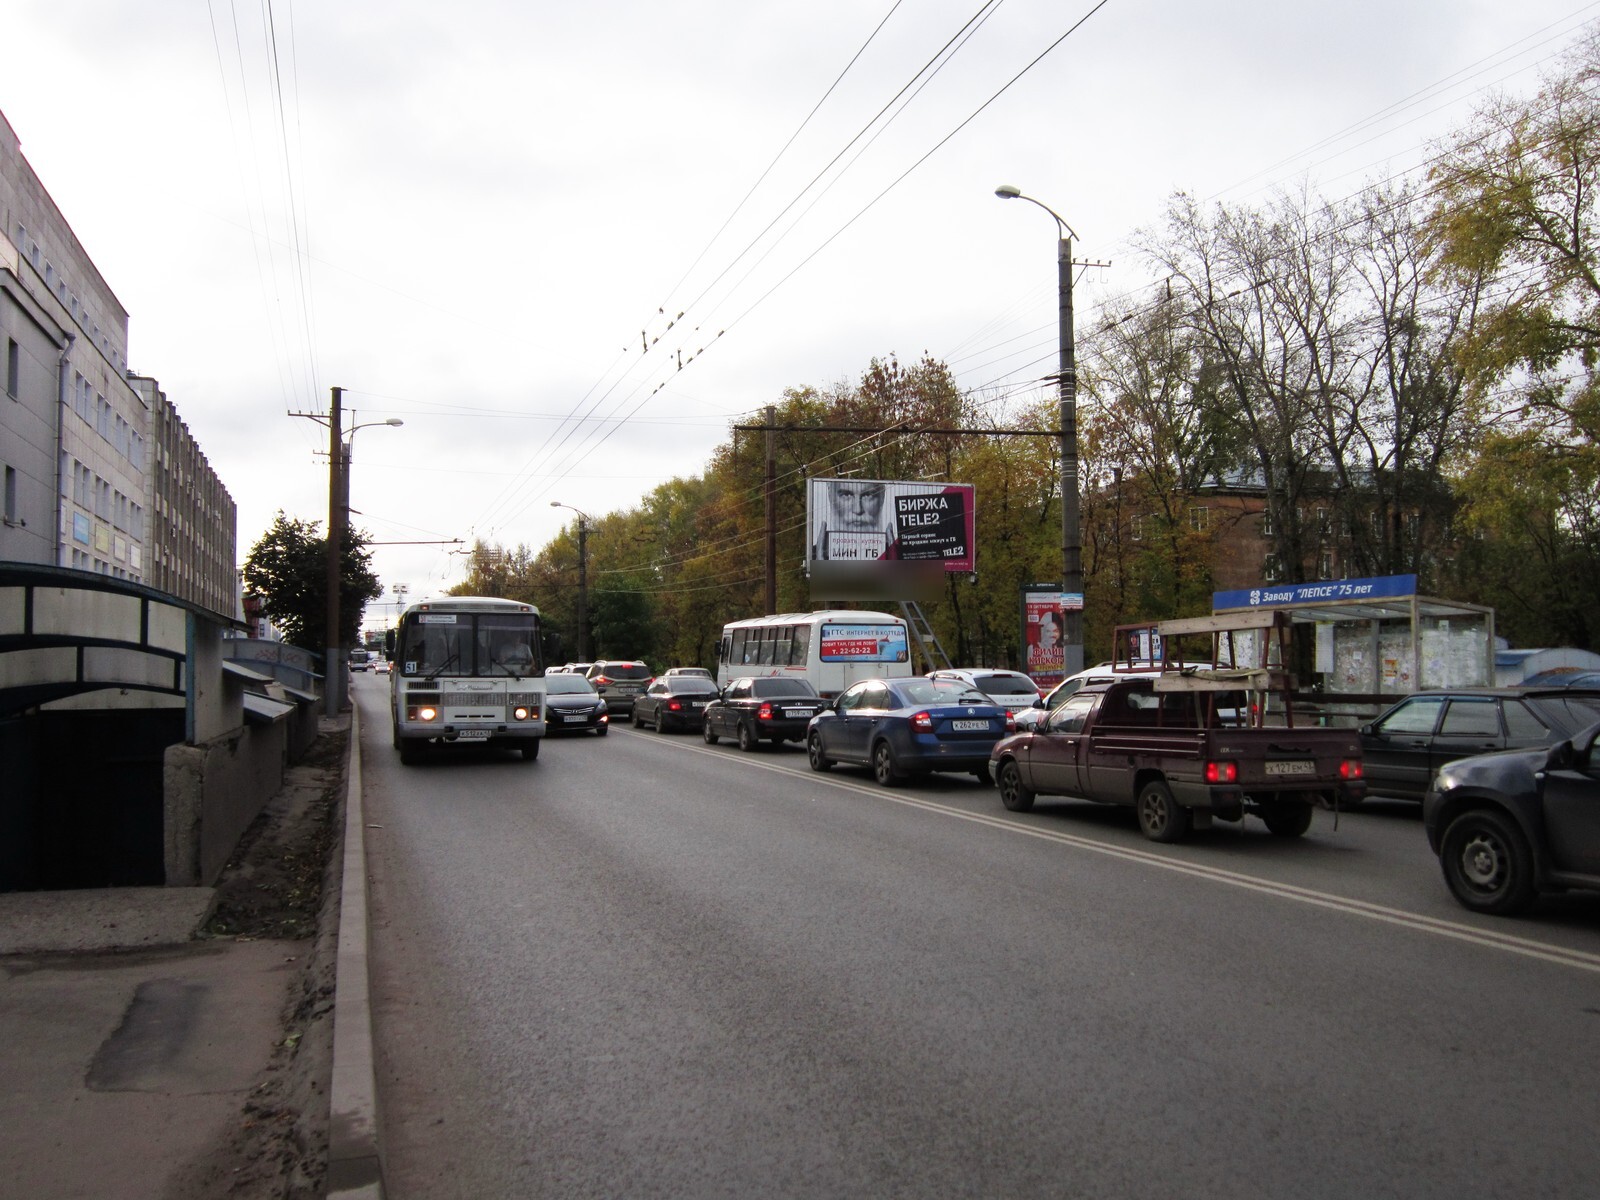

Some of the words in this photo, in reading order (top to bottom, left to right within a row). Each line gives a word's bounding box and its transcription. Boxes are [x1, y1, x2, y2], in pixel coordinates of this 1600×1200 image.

[898, 497, 949, 512] БИРЖА
[899, 512, 940, 527] TELE2
[832, 547, 857, 558] МИН
[865, 548, 879, 558] ГБ
[942, 545, 964, 557] TELE2
[1262, 592, 1295, 602] Заводу
[1338, 584, 1353, 595] 75
[1354, 584, 1373, 594] лет
[839, 647, 871, 655] 22-62-22
[406, 663, 416, 672] 51
